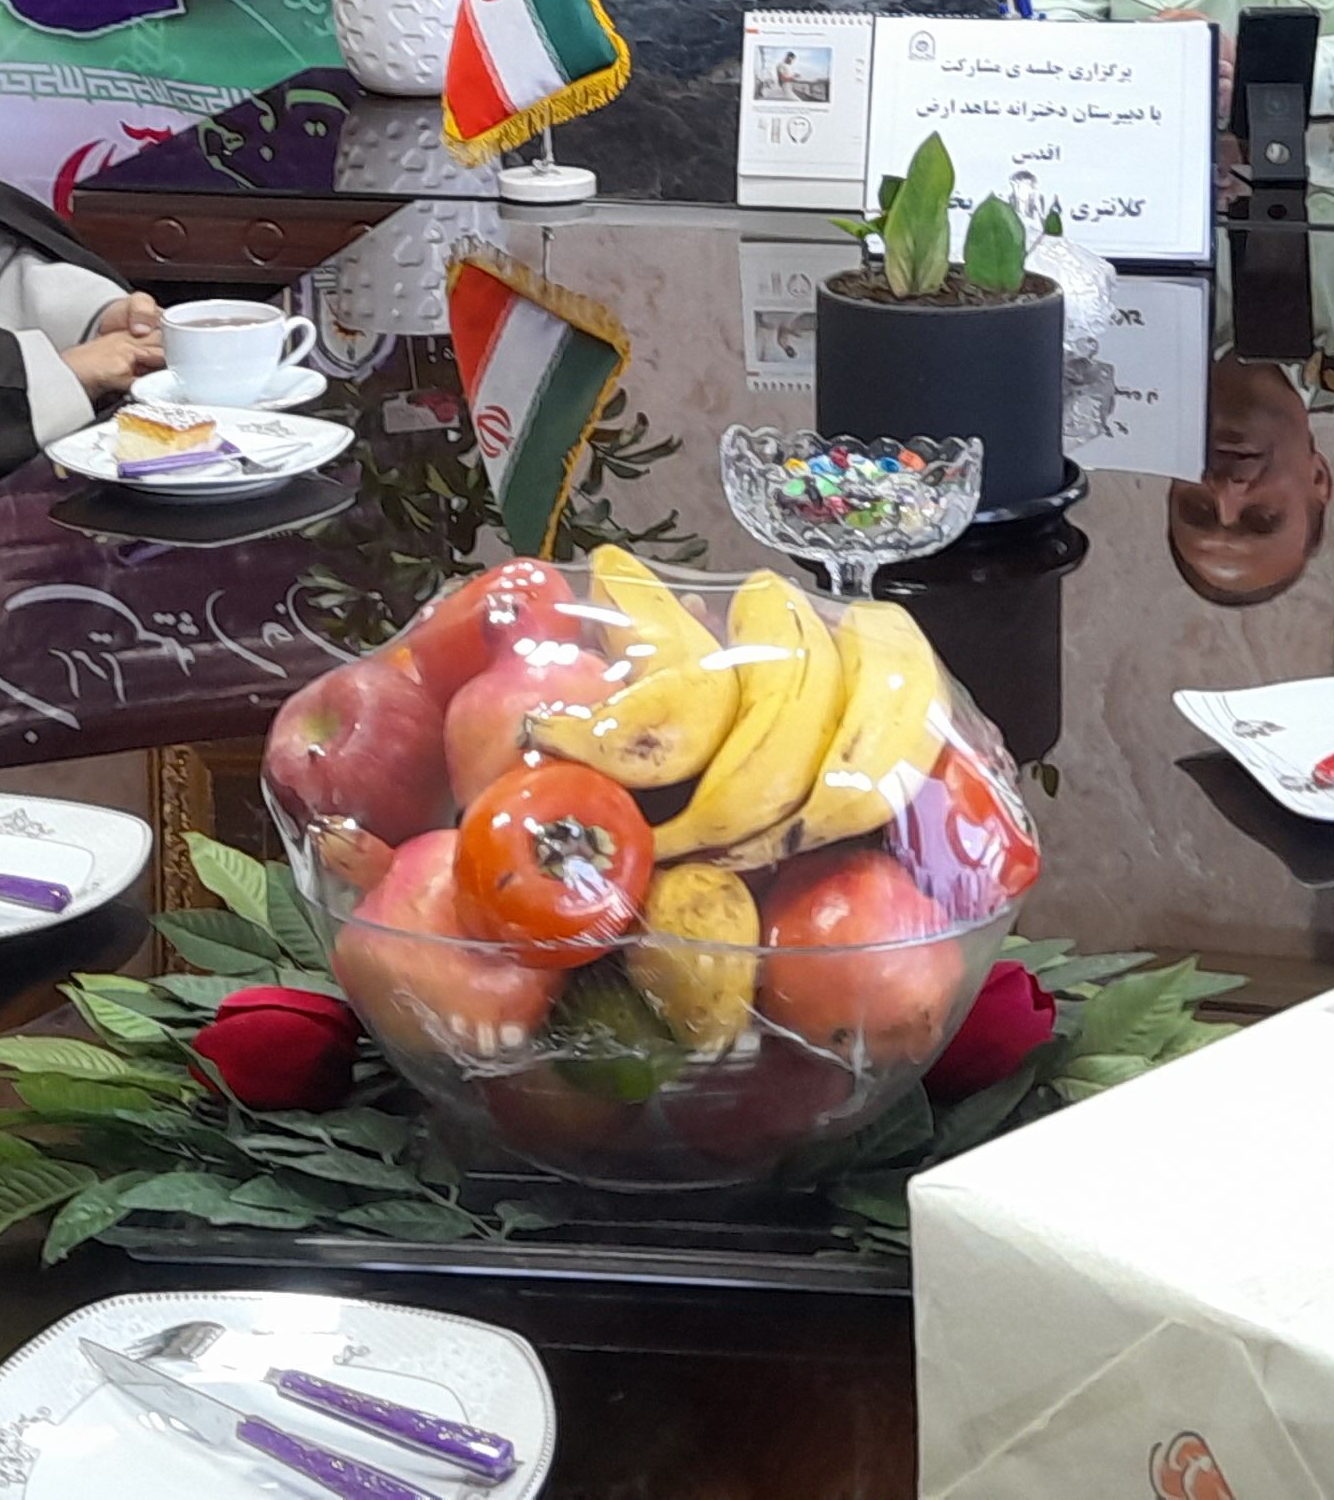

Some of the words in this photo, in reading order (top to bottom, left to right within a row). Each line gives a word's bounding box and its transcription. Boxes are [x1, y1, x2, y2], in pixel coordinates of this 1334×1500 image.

[940, 58, 1002, 77] مشارکت
[1005, 65, 1021, 79] ی
[1025, 60, 1063, 79] جلسه
[1068, 60, 1133, 83] برگزاری
[916, 97, 955, 119] ارض
[960, 99, 1002, 115] شاهد
[1006, 101, 1067, 122] دخترانه
[1072, 103, 1145, 126] دبیرستان
[1149, 103, 1162, 126] با
[1012, 144, 1061, 165] اقدس
[1070, 196, 1147, 223] کلانتری
